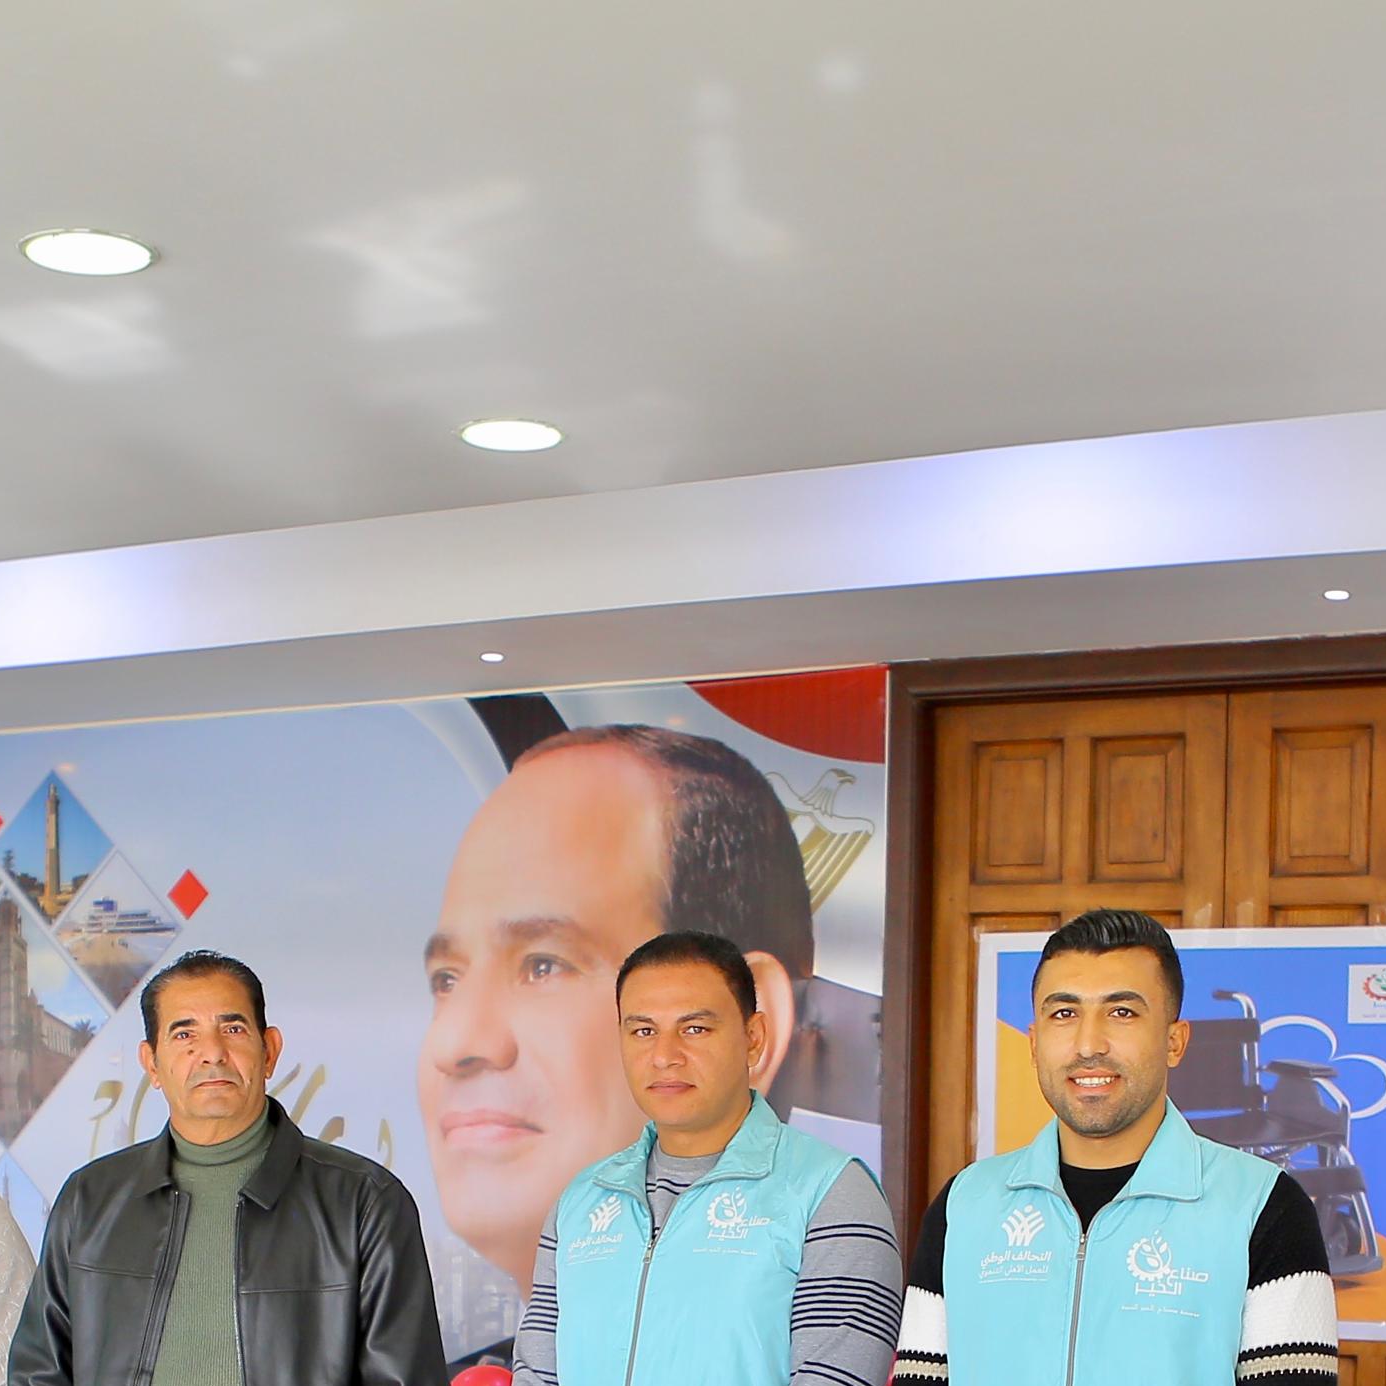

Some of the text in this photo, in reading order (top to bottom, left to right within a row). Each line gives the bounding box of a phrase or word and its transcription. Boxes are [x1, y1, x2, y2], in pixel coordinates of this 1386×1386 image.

[980, 1249, 1053, 1270] التحالف الوطني
[1166, 1266, 1210, 1288] صناع
[1134, 1280, 1183, 1297] الخير
